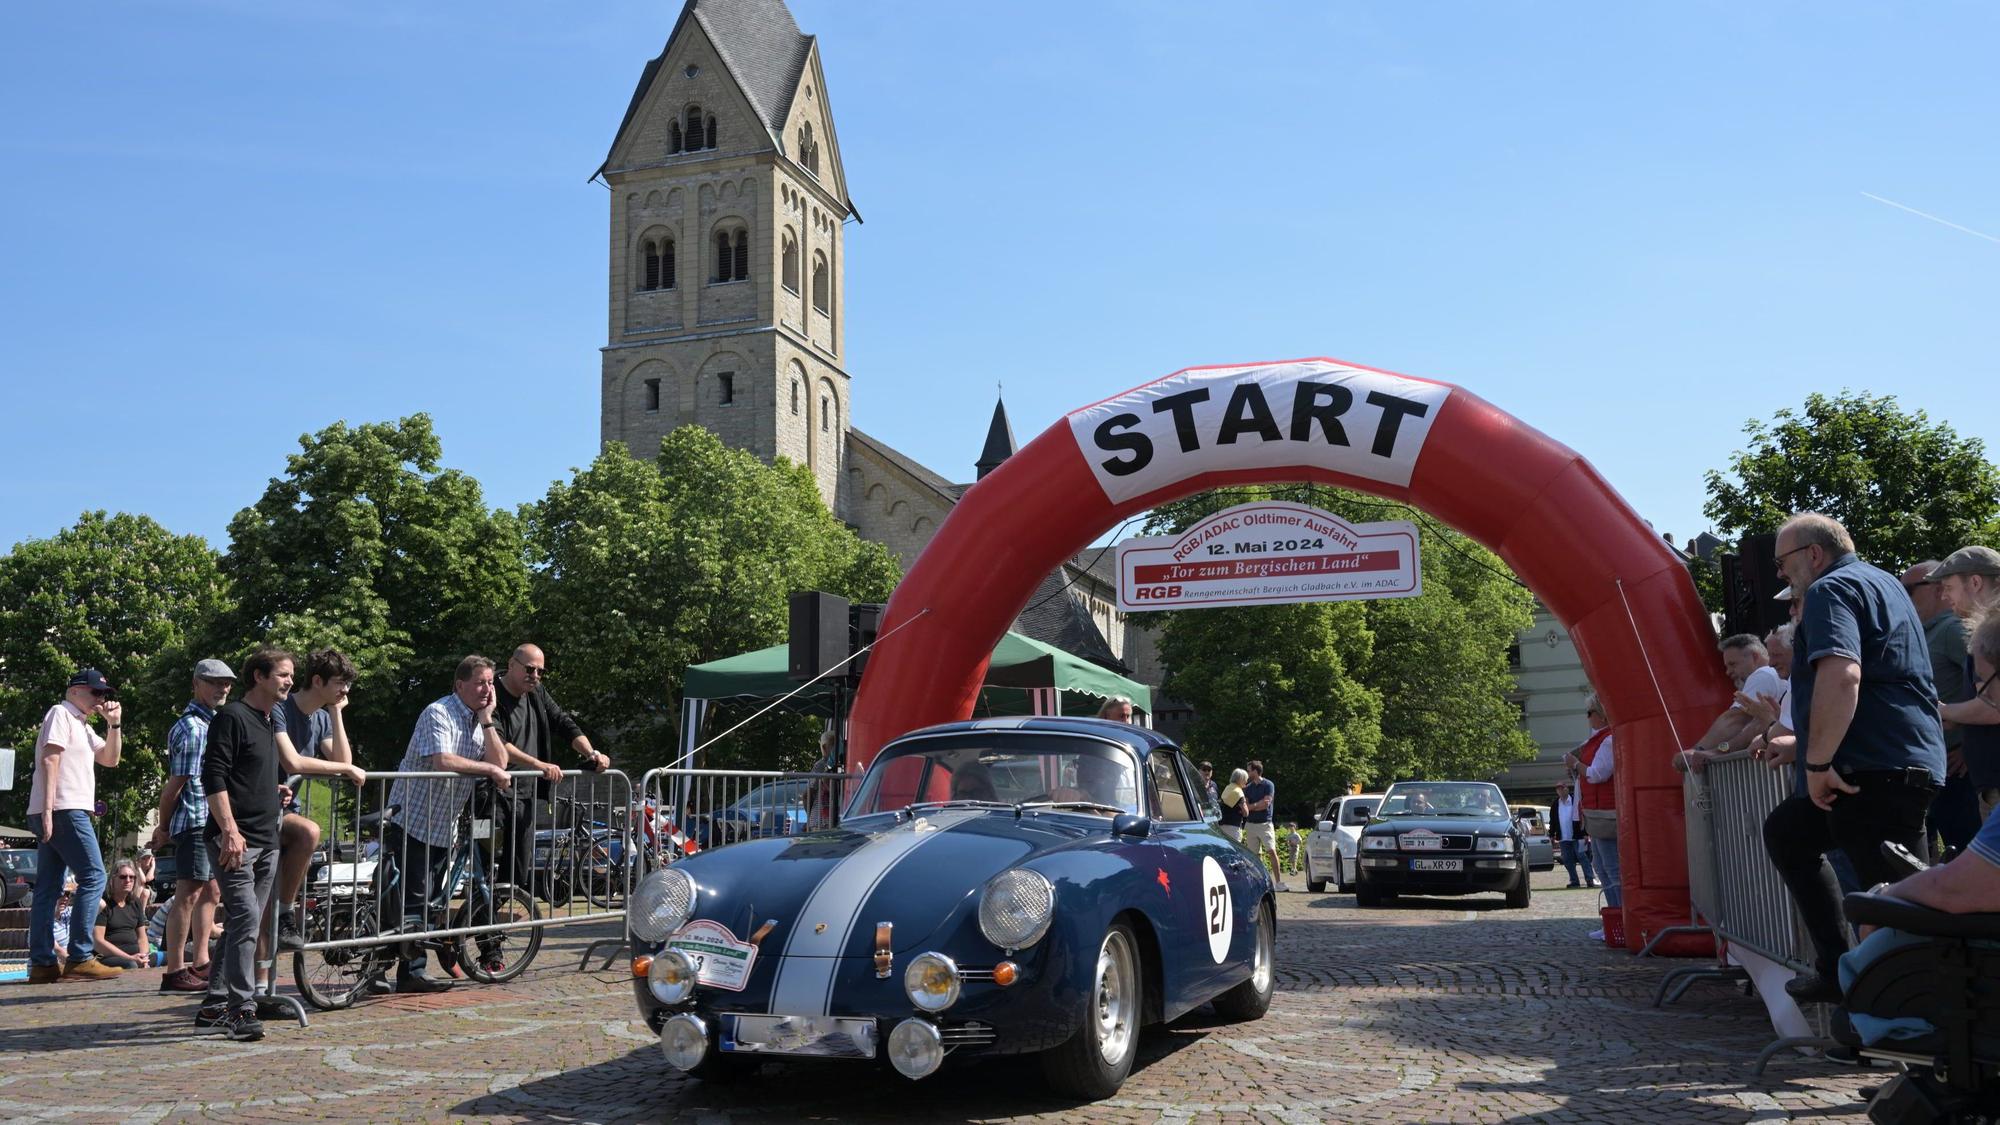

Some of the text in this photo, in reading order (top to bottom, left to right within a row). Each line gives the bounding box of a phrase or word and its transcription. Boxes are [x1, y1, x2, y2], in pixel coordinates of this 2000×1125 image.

[1093, 381, 1429, 477] START
[1173, 513, 1359, 562] RGB/ADAC Oldtimer Ausfahrt
[1206, 538, 1325, 556] 12. Mai 2024
[1199, 564, 1229, 577] zum
[1235, 558, 1317, 577] Bergischen
[1135, 578, 1400, 600] RGB Renngemeinschaft Bergisch Gladbach e.V. im ADAC
[1432, 860, 1444, 870] XR
[1445, 860, 1457, 870] 99
[1210, 884, 1227, 935] 27
